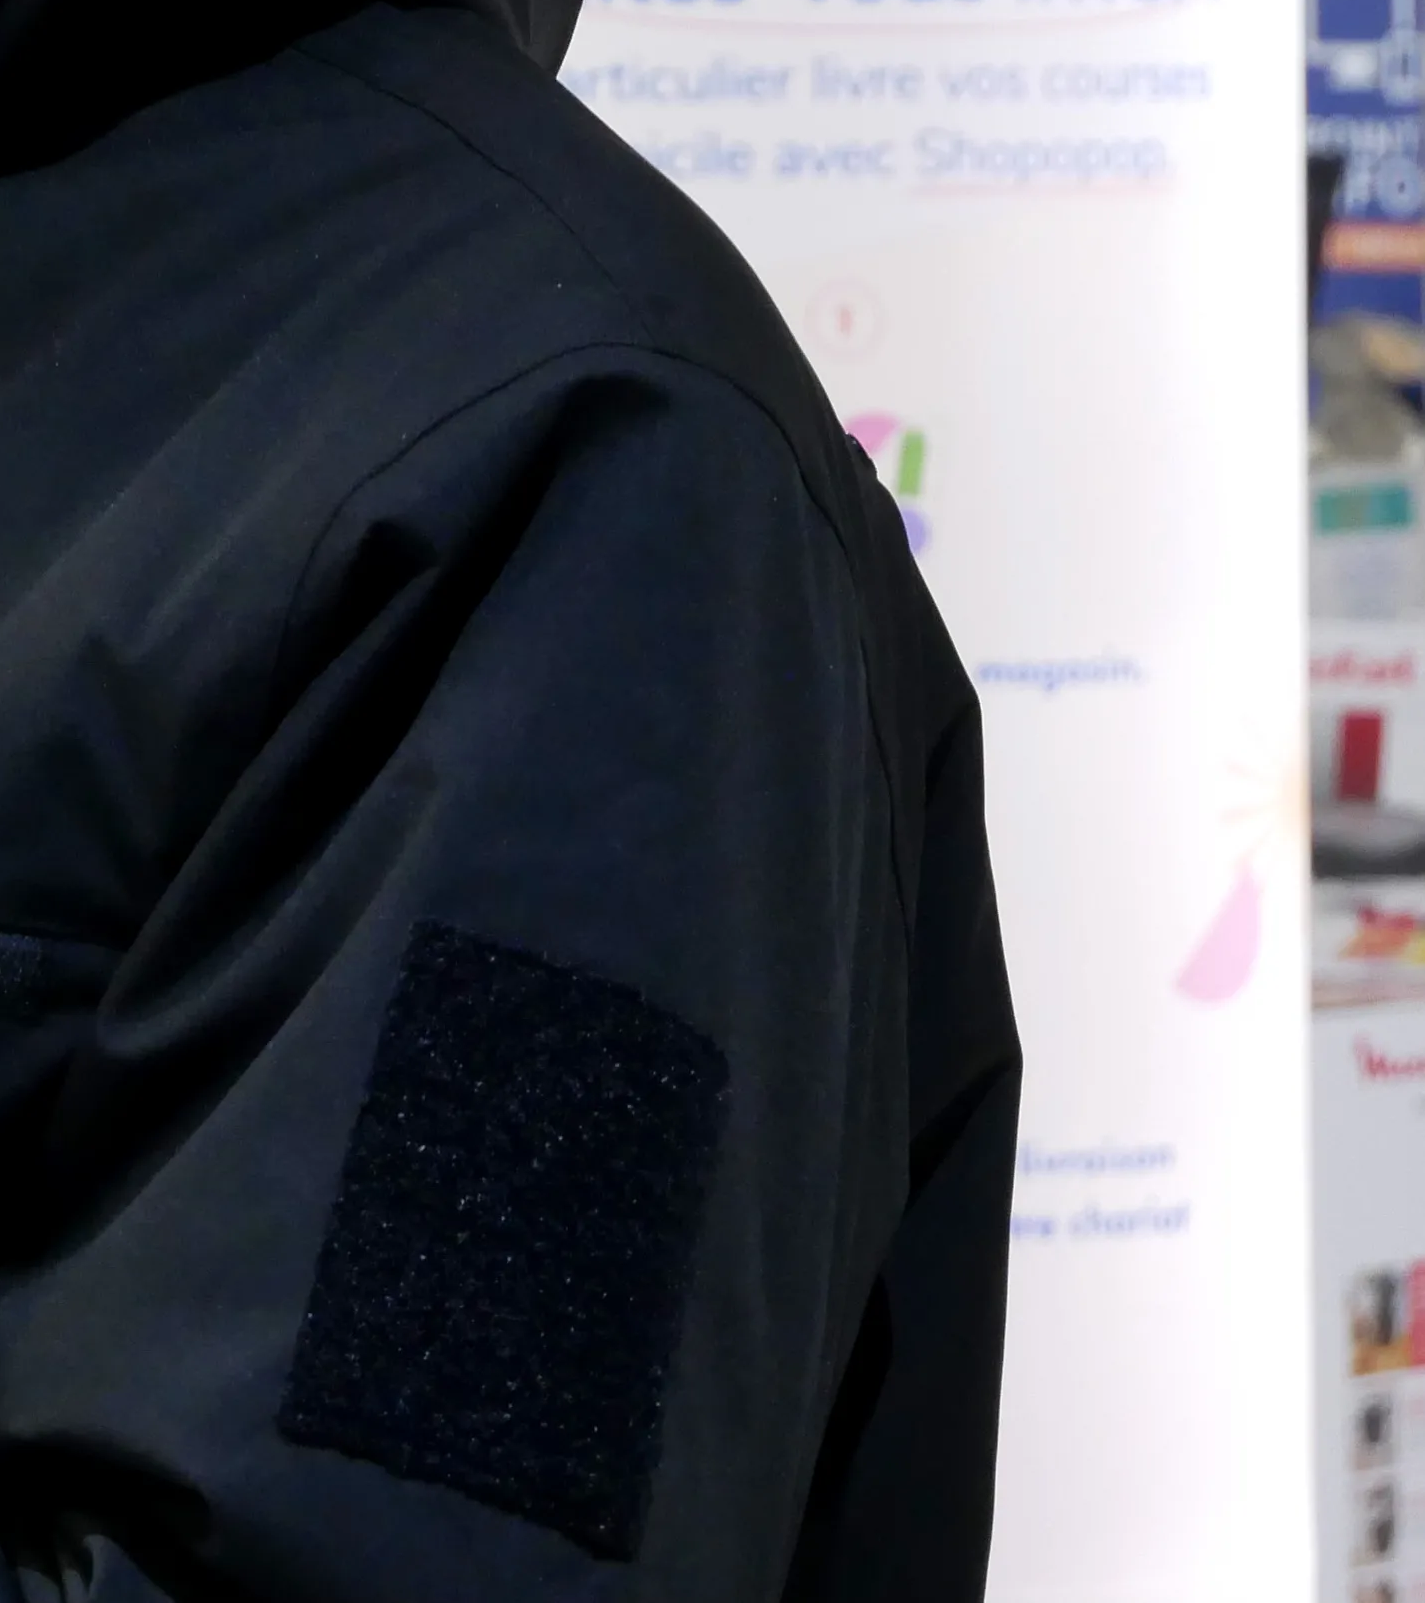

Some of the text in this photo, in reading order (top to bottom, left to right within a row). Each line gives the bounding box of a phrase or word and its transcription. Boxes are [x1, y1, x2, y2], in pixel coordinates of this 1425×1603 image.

[811, 58, 924, 101] livre
[938, 64, 1029, 100] vos
[773, 139, 895, 178] avec
